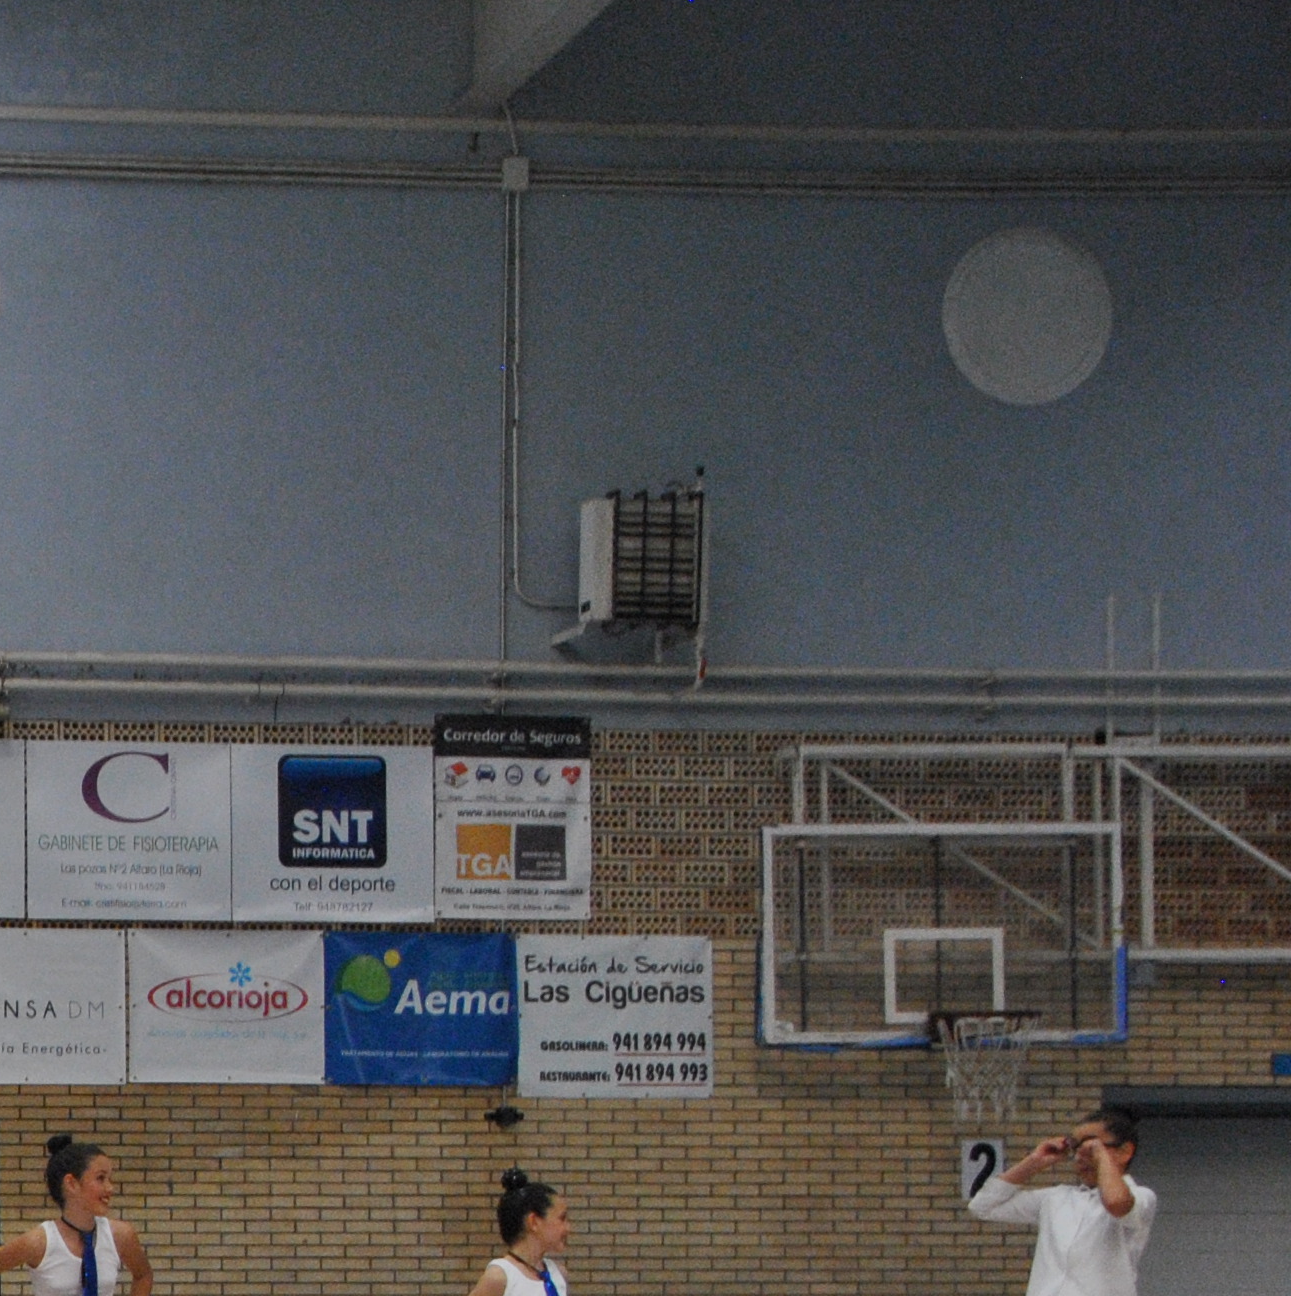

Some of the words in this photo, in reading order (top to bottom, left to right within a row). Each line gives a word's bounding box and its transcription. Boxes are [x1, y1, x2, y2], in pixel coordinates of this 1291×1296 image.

[443, 728, 506, 742] Corredor
[509, 729, 525, 742] de
[529, 729, 582, 746] Seguros
[292, 809, 373, 845] SNT
[38, 834, 103, 851] GABINETE
[108, 835, 126, 851] DE
[133, 835, 219, 852] FISIOTERAPIA
[292, 847, 376, 860] INFORMATICA
[458, 853, 513, 877] TGA
[269, 878, 301, 892] con
[307, 875, 323, 892] el
[328, 876, 396, 895] deporte
[524, 954, 598, 974] Estación
[606, 957, 627, 974] de
[634, 956, 704, 974] Servicio
[394, 979, 510, 1015] Aema
[523, 980, 569, 1003] Las
[585, 980, 705, 1010] Cigüeñas
[68, 1001, 105, 1020] DM
[612, 1032, 639, 1051] 941
[643, 1032, 672, 1051] 894
[676, 1032, 706, 1051] 994
[614, 1062, 641, 1082] 941
[645, 1062, 675, 1082] 894
[679, 1063, 708, 1082] 993
